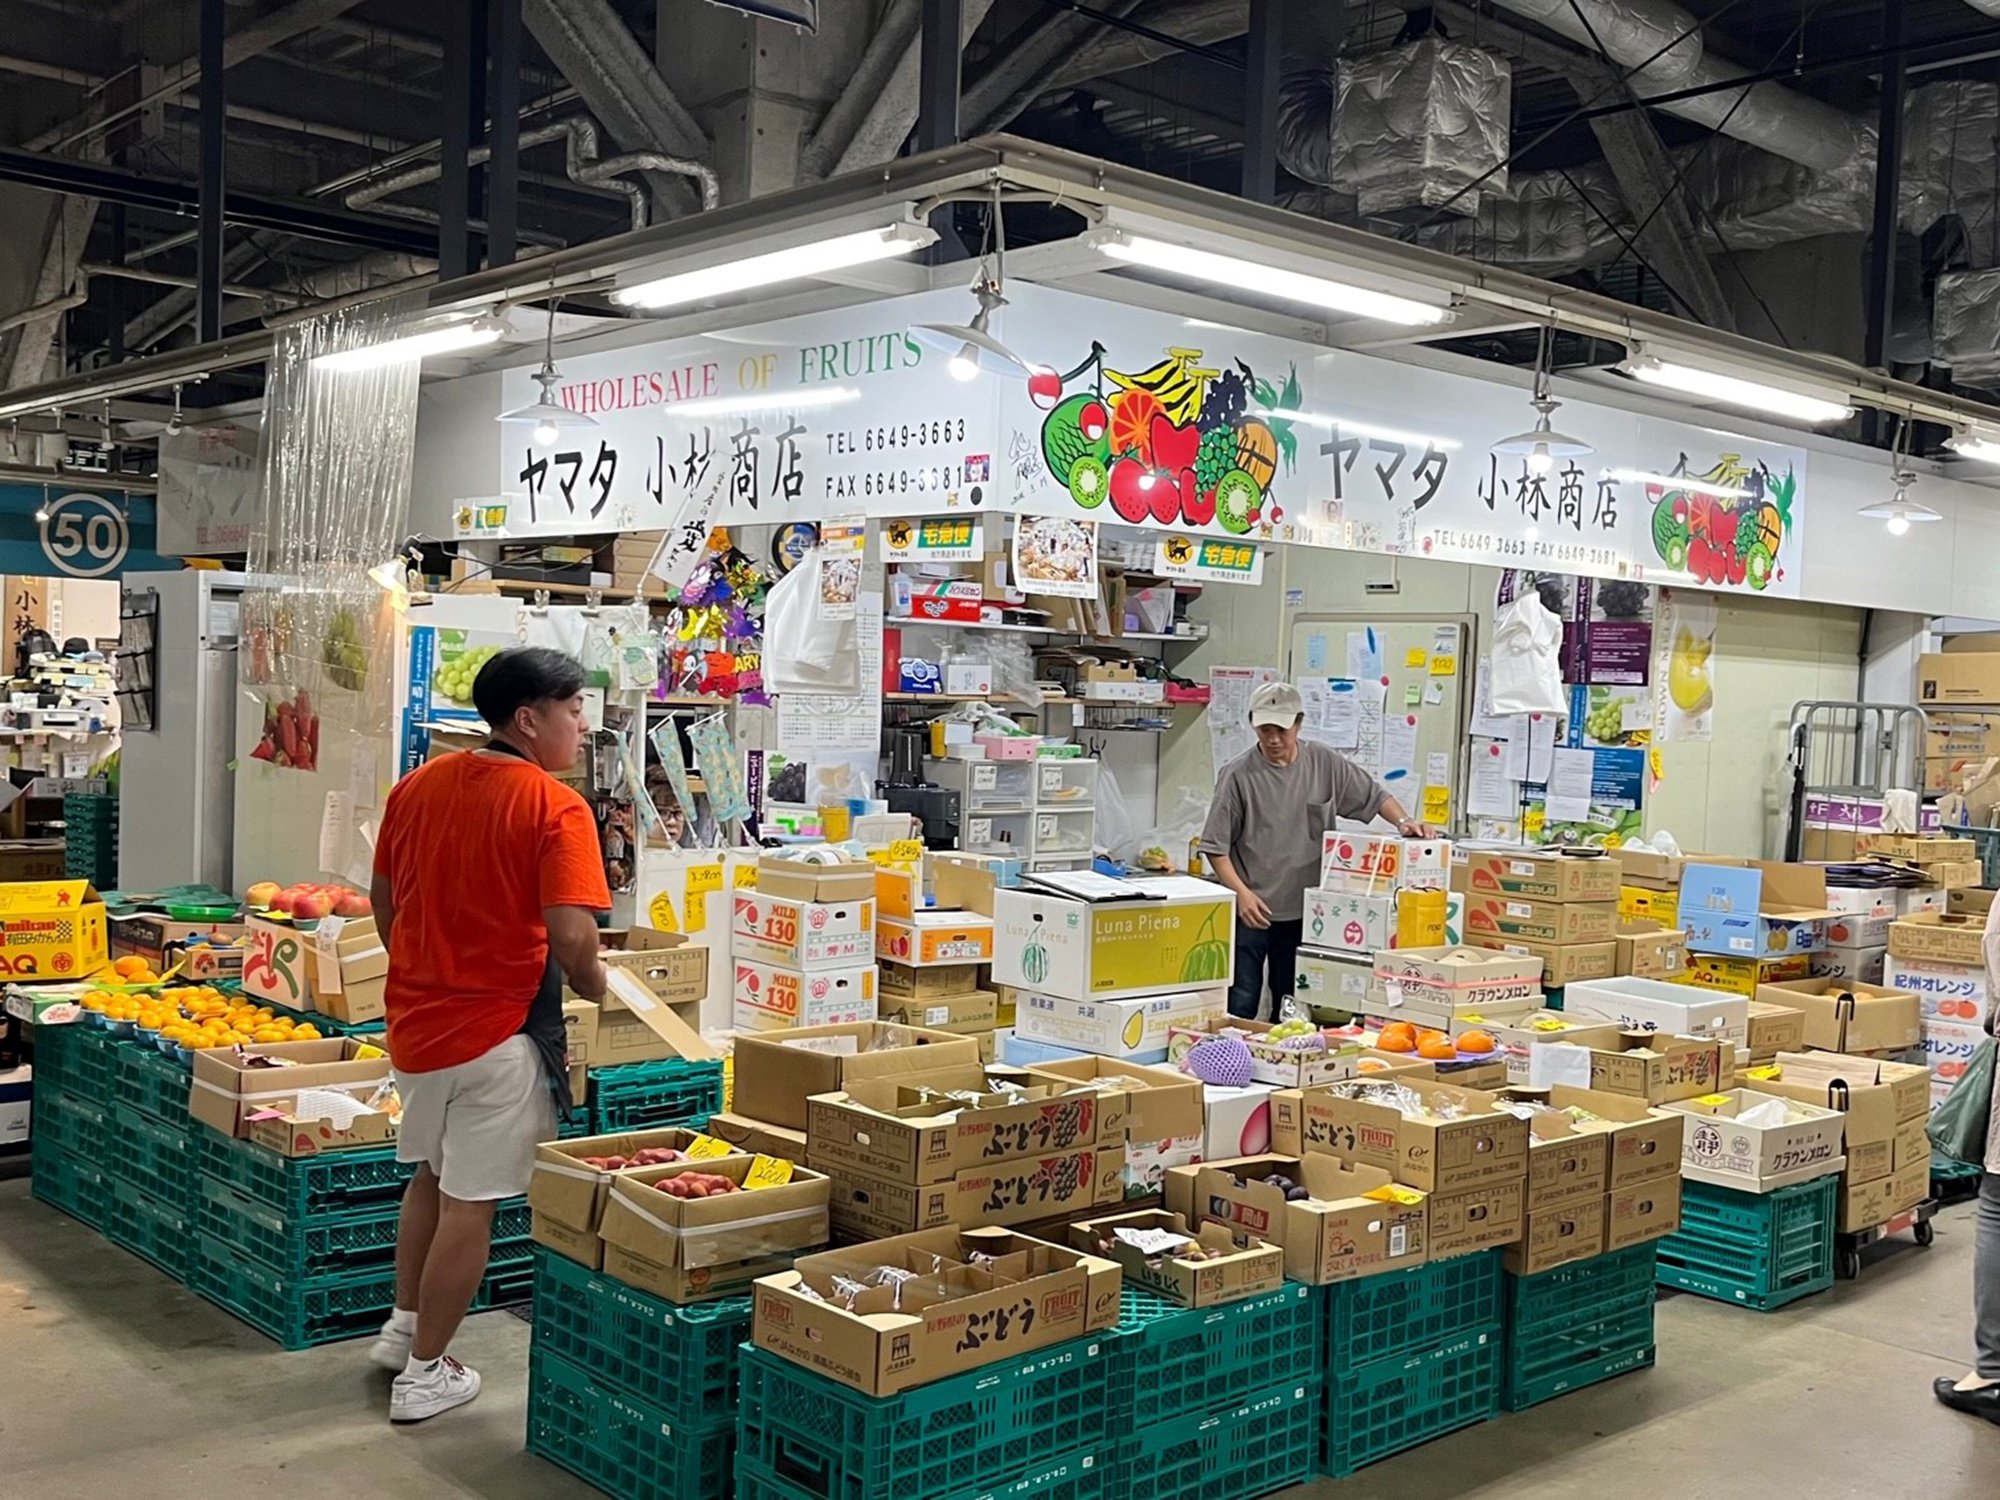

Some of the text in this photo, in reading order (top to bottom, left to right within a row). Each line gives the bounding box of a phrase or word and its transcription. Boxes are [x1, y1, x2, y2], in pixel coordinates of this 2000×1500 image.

[561, 331, 921, 415] WHOLESALE OF FRUITS
[826, 418, 965, 454] TEL 6649-3663
[520, 440, 617, 523] ヤマタ
[826, 475, 856, 498] FAX
[1320, 423, 1621, 531] ヤマタ 小林商店
[52, 513, 119, 558] 50
[924, 522, 970, 545] 宅急便
[1205, 544, 1253, 568] 宅急便
[1433, 529, 1616, 566] TEL 6649-3663 FAX 6649-3681
[1369, 842, 1397, 855] MLD
[771, 904, 796, 919] MILD
[765, 918, 796, 941] 130
[1006, 923, 1068, 944] Luna Piena
[1096, 914, 1180, 934] Luna Piena
[773, 974, 798, 989] MILD
[1894, 974, 1976, 995] 紀州オレンジ
[767, 987, 797, 1010] 130
[1467, 985, 1532, 1004] クラウンメロン
[983, 1117, 1050, 1158] ぶどう
[1304, 1117, 1355, 1150] ぶどう
[1360, 1127, 1394, 1148] FRUIT
[1772, 1144, 1834, 1171] クラウンメロン
[983, 1174, 1051, 1214] ぶどう
[1141, 1268, 1180, 1293] いちじく
[763, 1298, 791, 1320] FRUIT
[1044, 1289, 1080, 1317] FRUIT
[956, 1297, 1035, 1353] ぶどう
